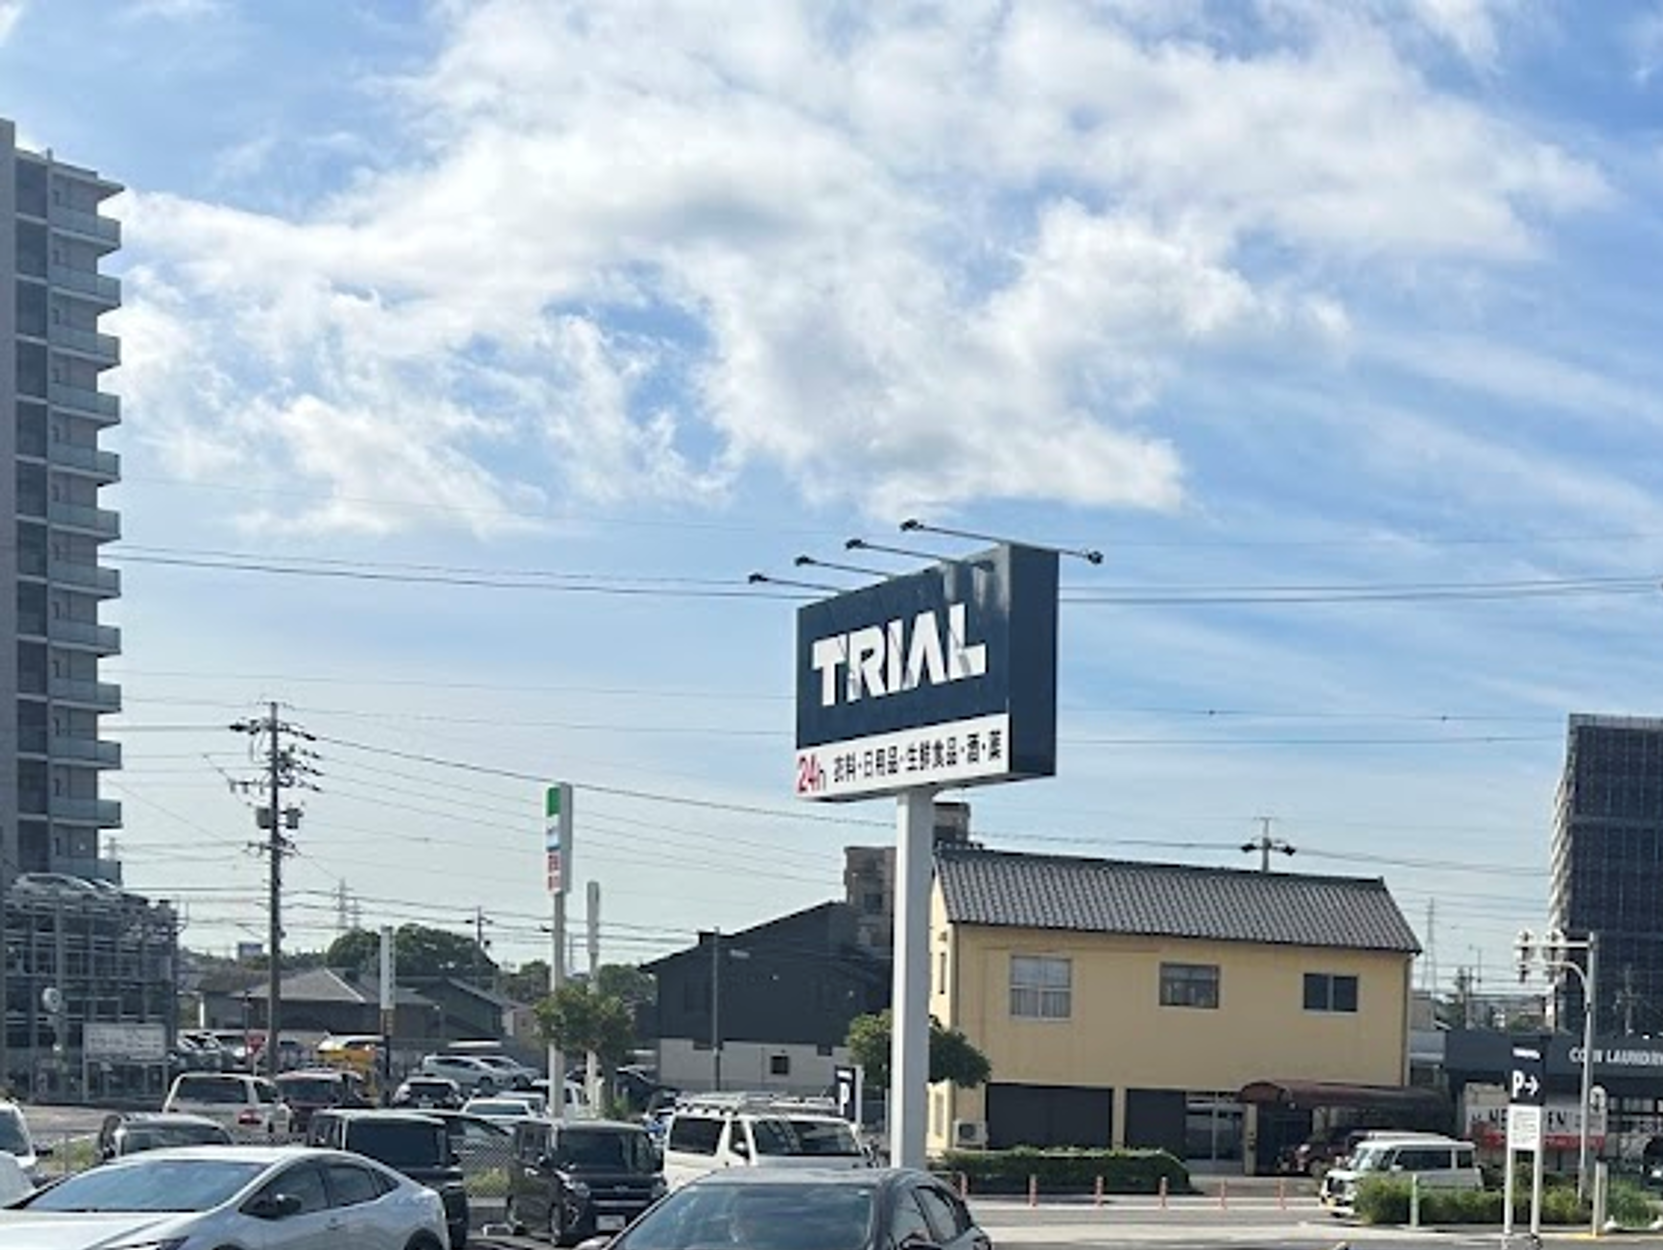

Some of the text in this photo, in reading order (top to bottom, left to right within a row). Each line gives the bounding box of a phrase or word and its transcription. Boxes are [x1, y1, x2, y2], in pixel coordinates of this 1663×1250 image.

[812, 603, 987, 706] TRIAL
[797, 755, 826, 792] 24h
[1569, 1047, 1602, 1062] CON
[839, 1082, 850, 1116] P
[1513, 1070, 1525, 1098] P
